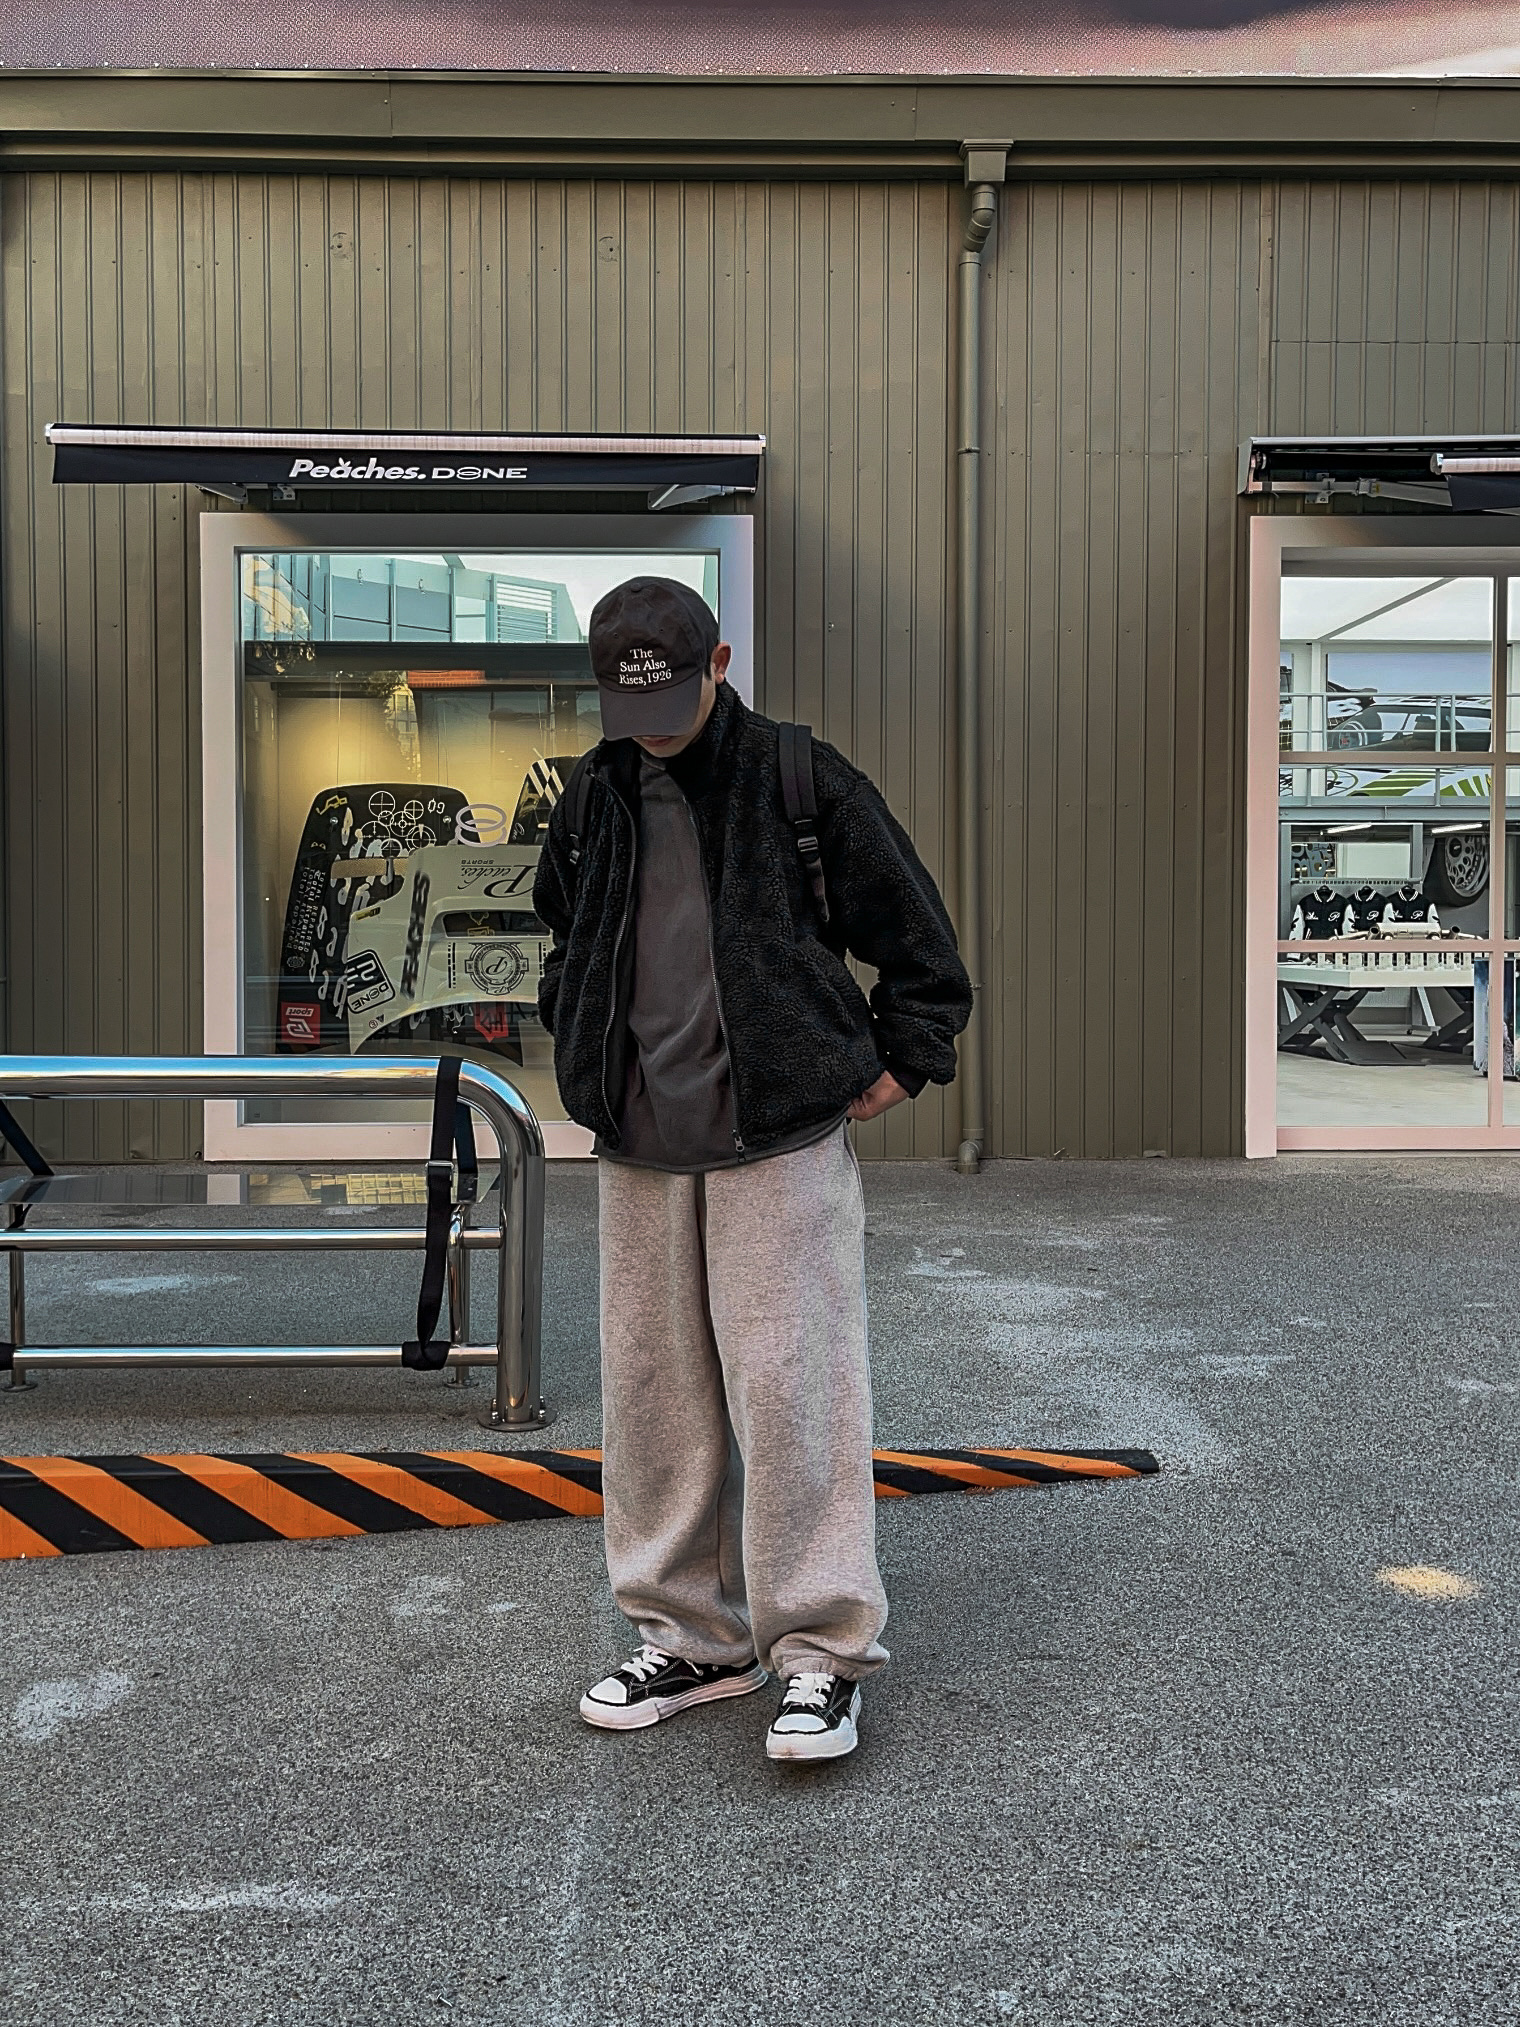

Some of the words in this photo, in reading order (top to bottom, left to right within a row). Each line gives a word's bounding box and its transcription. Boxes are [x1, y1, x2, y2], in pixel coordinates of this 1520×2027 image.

[288, 457, 427, 480] Peaches.
[432, 466, 528, 480] DONE
[630, 648, 653, 659] The
[620, 661, 640, 672] Sun
[643, 659, 666, 671] Also
[351, 982, 390, 1011] DONE
